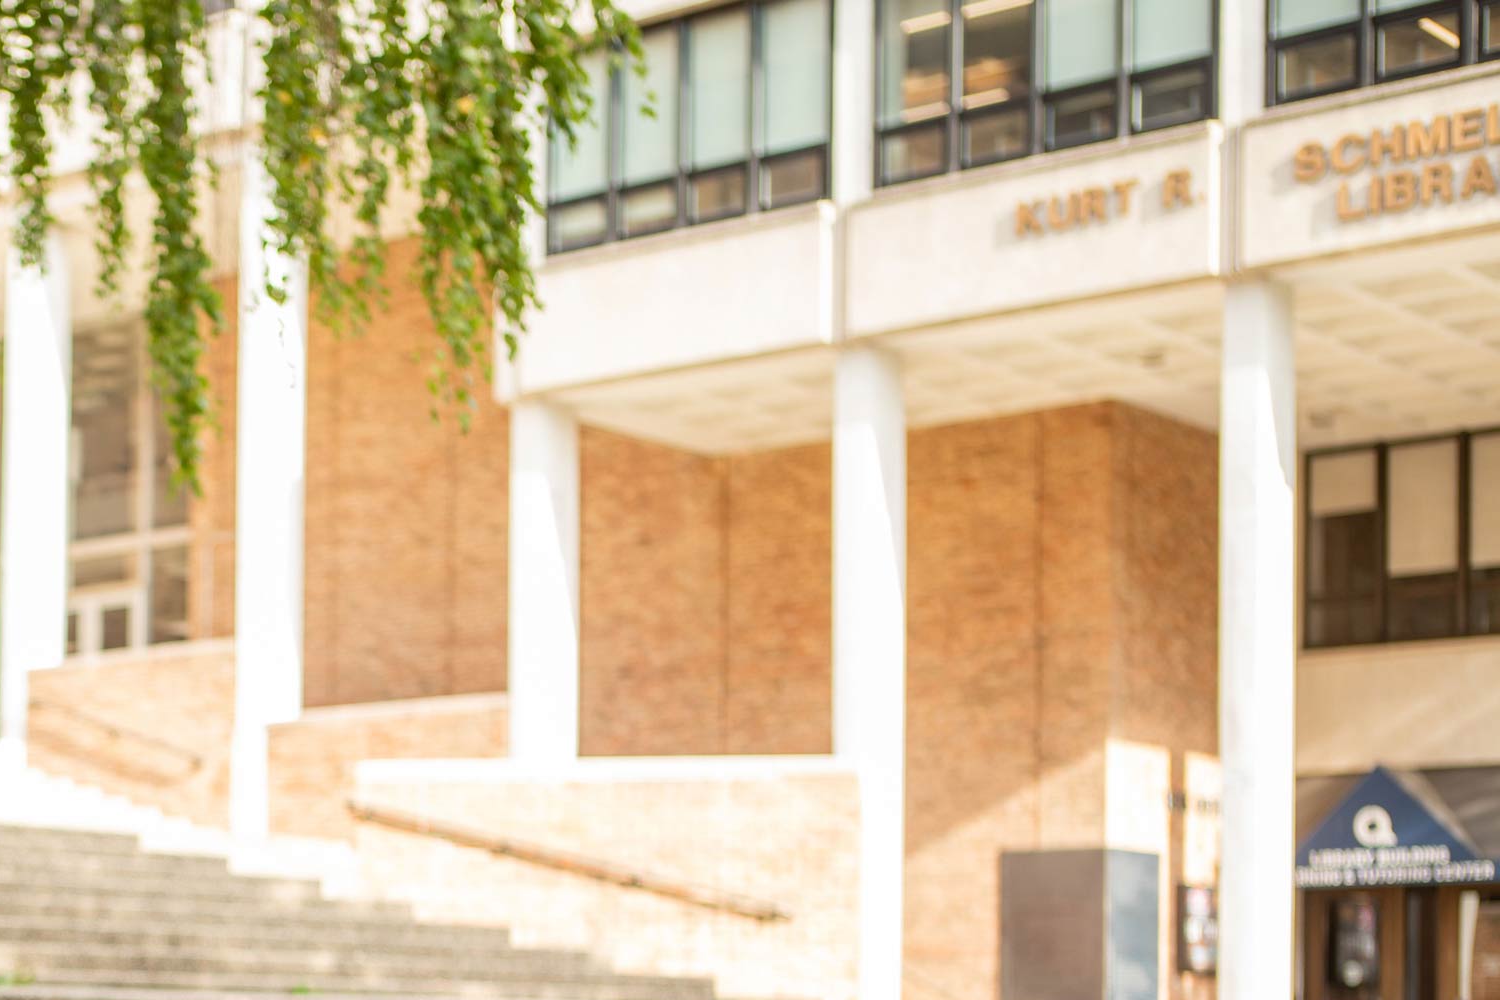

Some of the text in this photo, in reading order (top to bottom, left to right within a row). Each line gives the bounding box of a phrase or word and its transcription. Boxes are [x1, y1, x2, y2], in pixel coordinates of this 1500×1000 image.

[1015, 178, 1140, 237] KURT
[1336, 154, 1497, 222] LIBRA
[1376, 844, 1451, 868] BUILDING
[1434, 859, 1495, 882] CENTER
